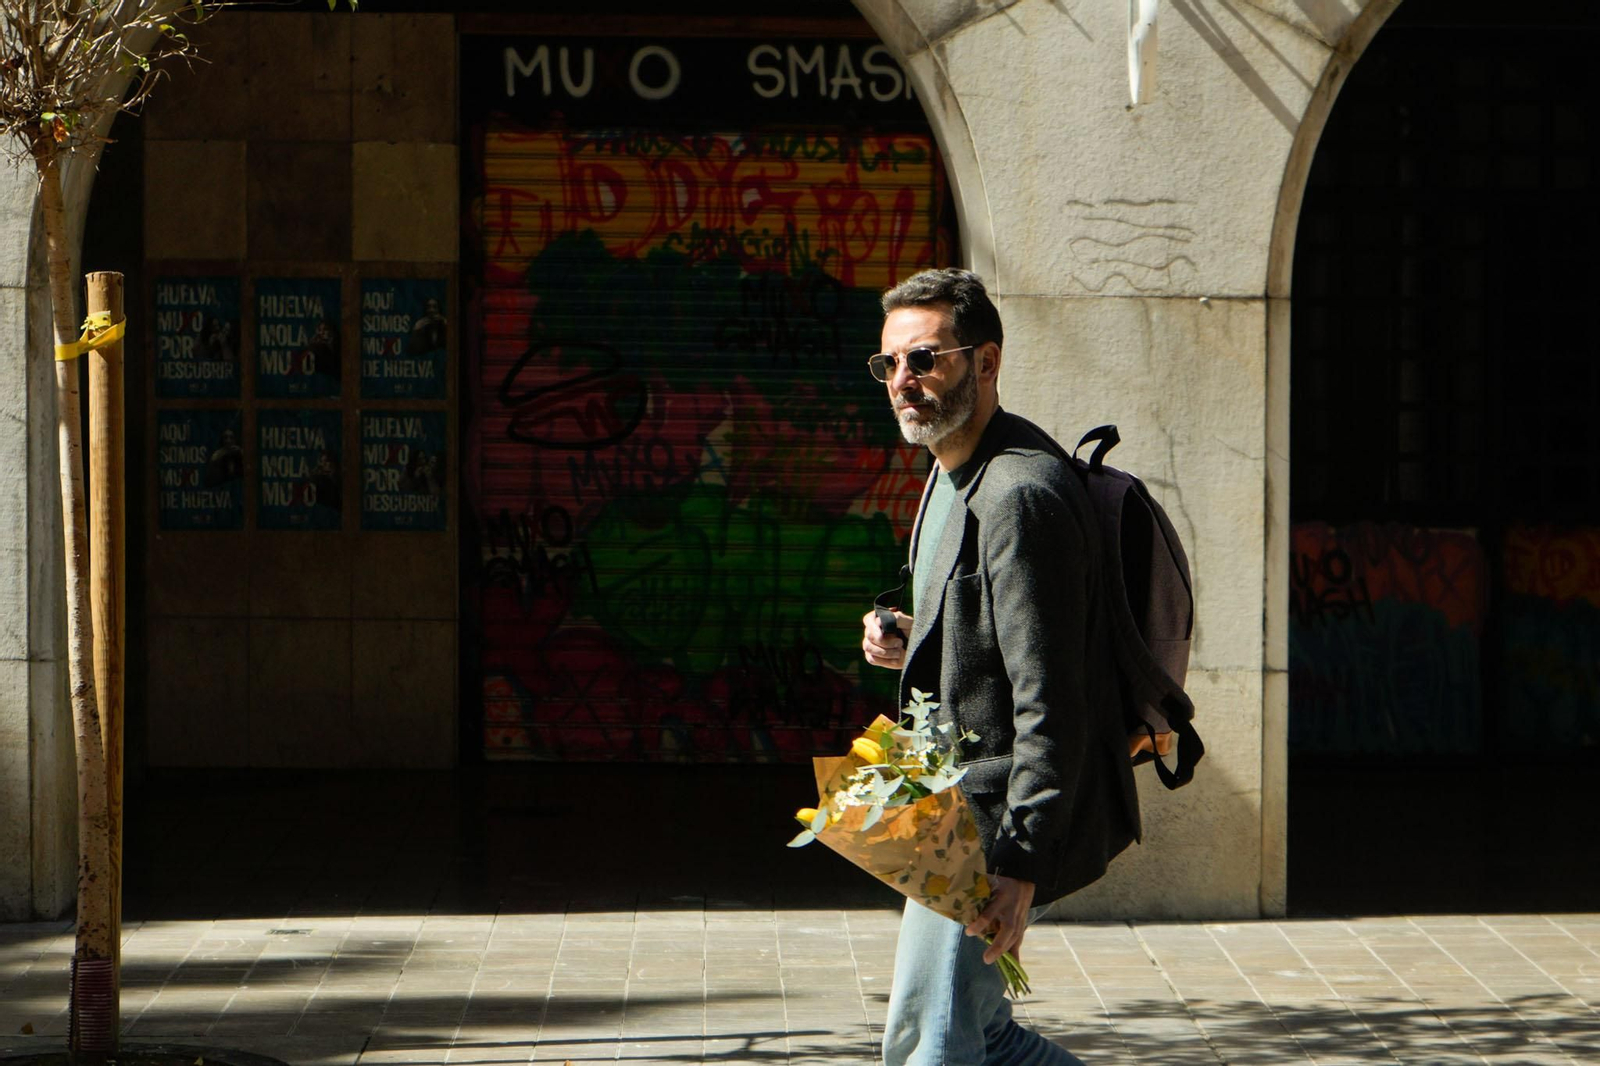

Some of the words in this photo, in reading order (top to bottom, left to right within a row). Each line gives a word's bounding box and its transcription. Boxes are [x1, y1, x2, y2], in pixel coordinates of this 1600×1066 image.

[260, 295, 325, 318] HUELVA
[260, 324, 309, 347] MOLA
[362, 314, 411, 334] SOMOS
[159, 335, 194, 359] POR
[158, 361, 234, 379] DESCUBRIR
[260, 349, 316, 376] MUXO
[363, 359, 380, 378] DE
[383, 359, 436, 379] HUELVA
[261, 426, 327, 450] HUELVA
[160, 445, 209, 464] SOMOS
[261, 454, 310, 478] MOLA
[364, 468, 400, 492] POR
[161, 490, 178, 509] DE
[181, 490, 233, 510] HUELVA
[261, 481, 317, 507] MUXO
[363, 493, 440, 513] DESCUBRIR
